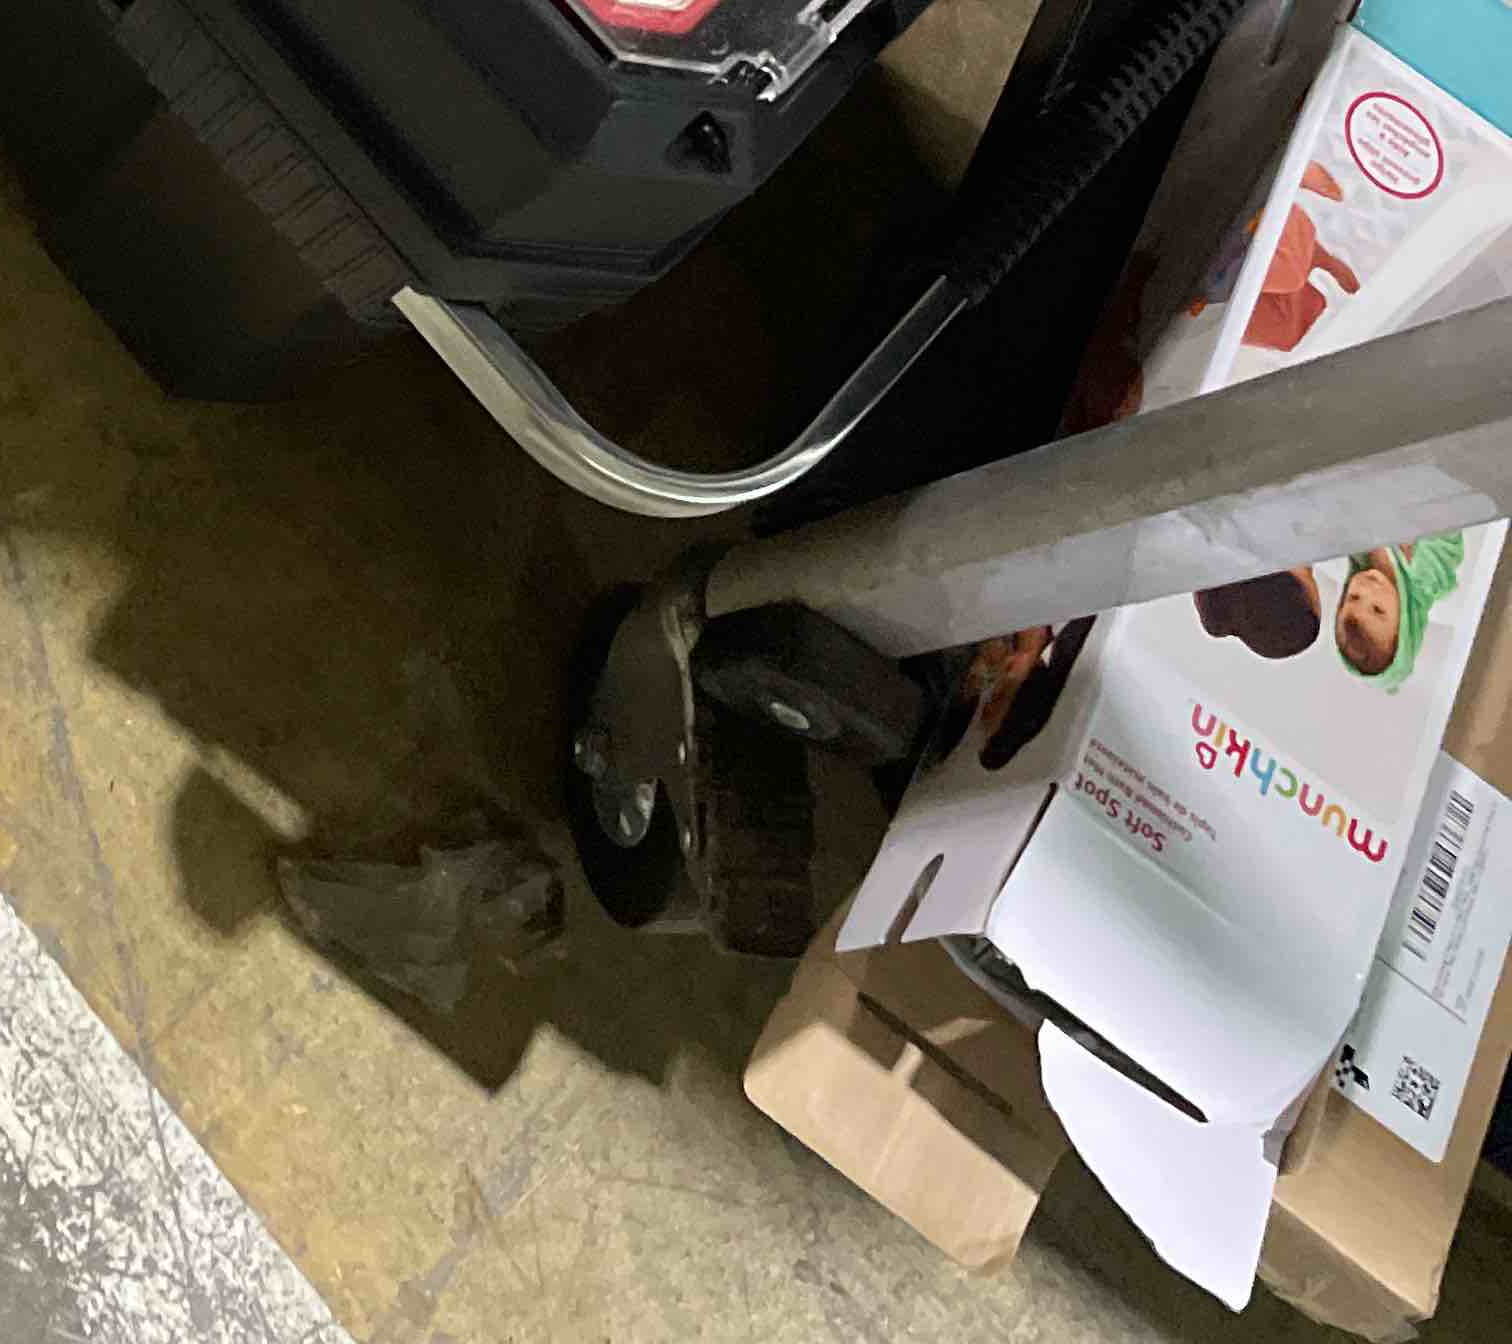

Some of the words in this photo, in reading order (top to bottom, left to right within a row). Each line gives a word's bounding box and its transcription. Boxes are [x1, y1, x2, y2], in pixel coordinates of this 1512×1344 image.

[1074, 773, 1122, 818] Spot
[1192, 703, 1388, 862] munchkin
[1125, 811, 1167, 852] Soft
